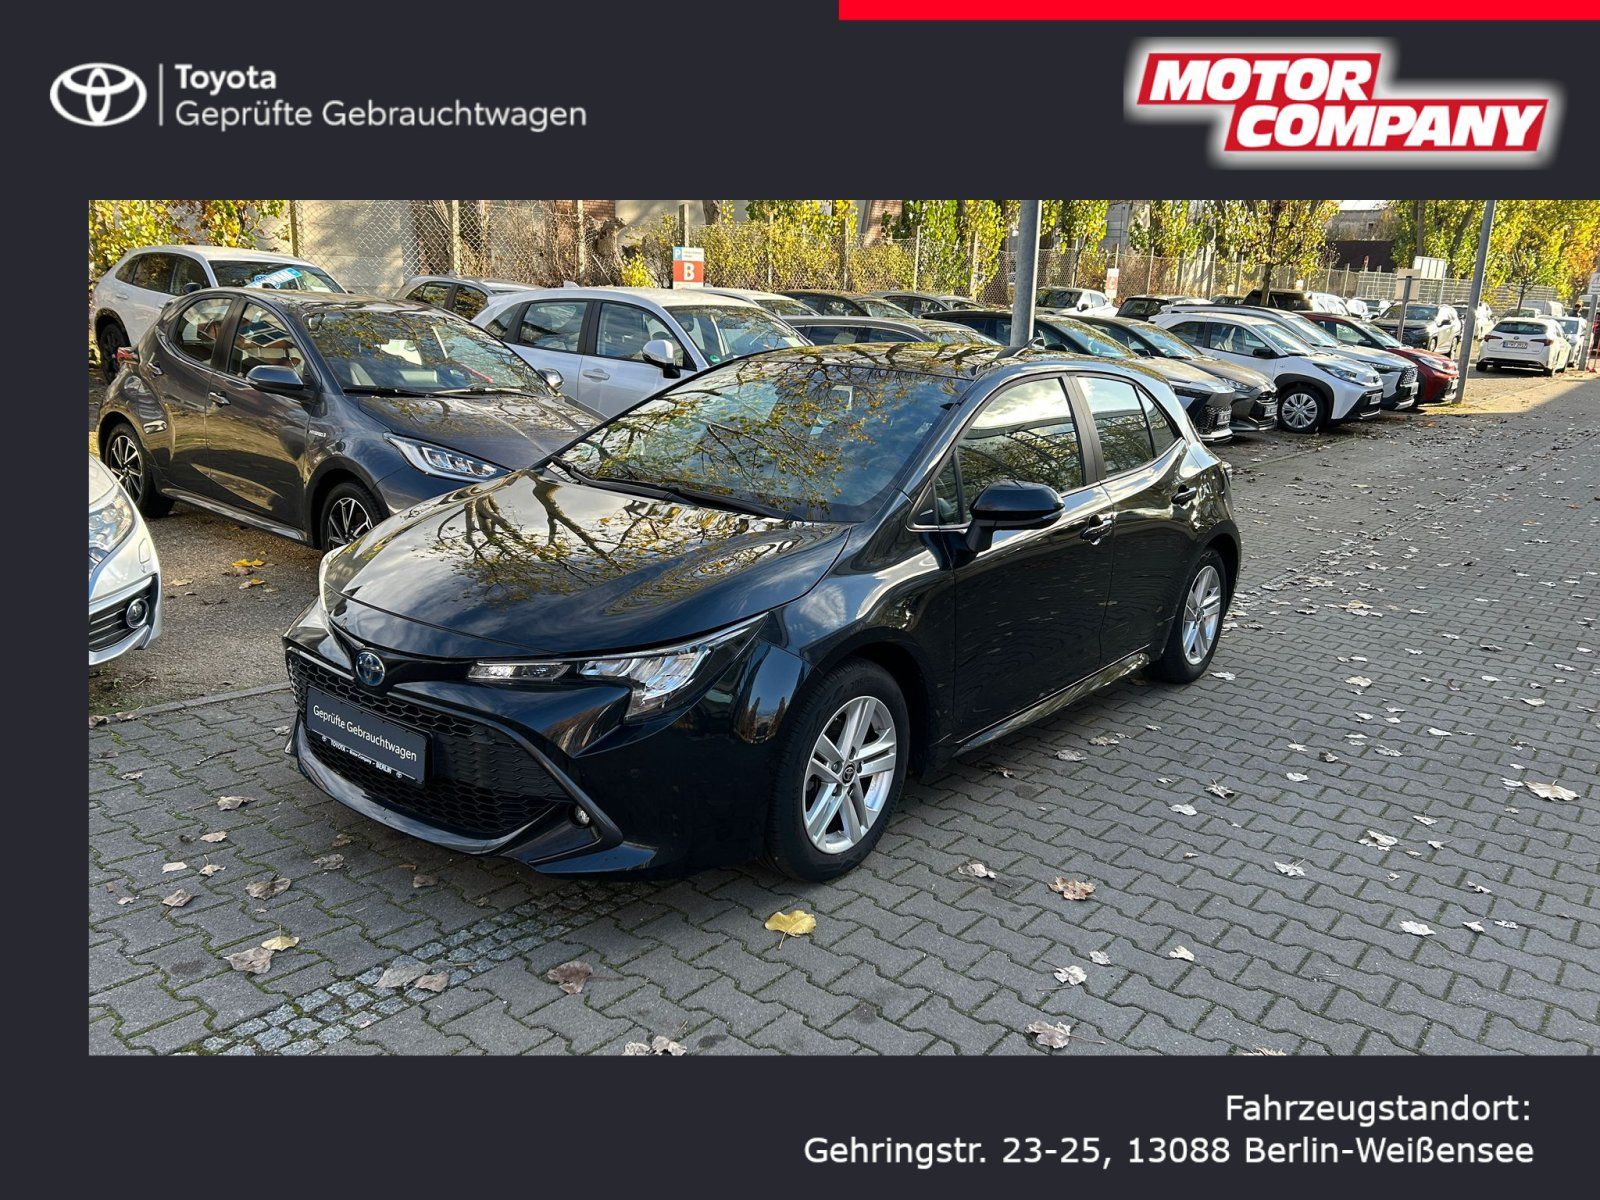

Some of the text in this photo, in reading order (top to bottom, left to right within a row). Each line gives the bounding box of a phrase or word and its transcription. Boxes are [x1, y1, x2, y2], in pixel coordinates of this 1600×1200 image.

[683, 261, 695, 281] B
[313, 704, 417, 762] Geprüfte Gebrauchtwagen
